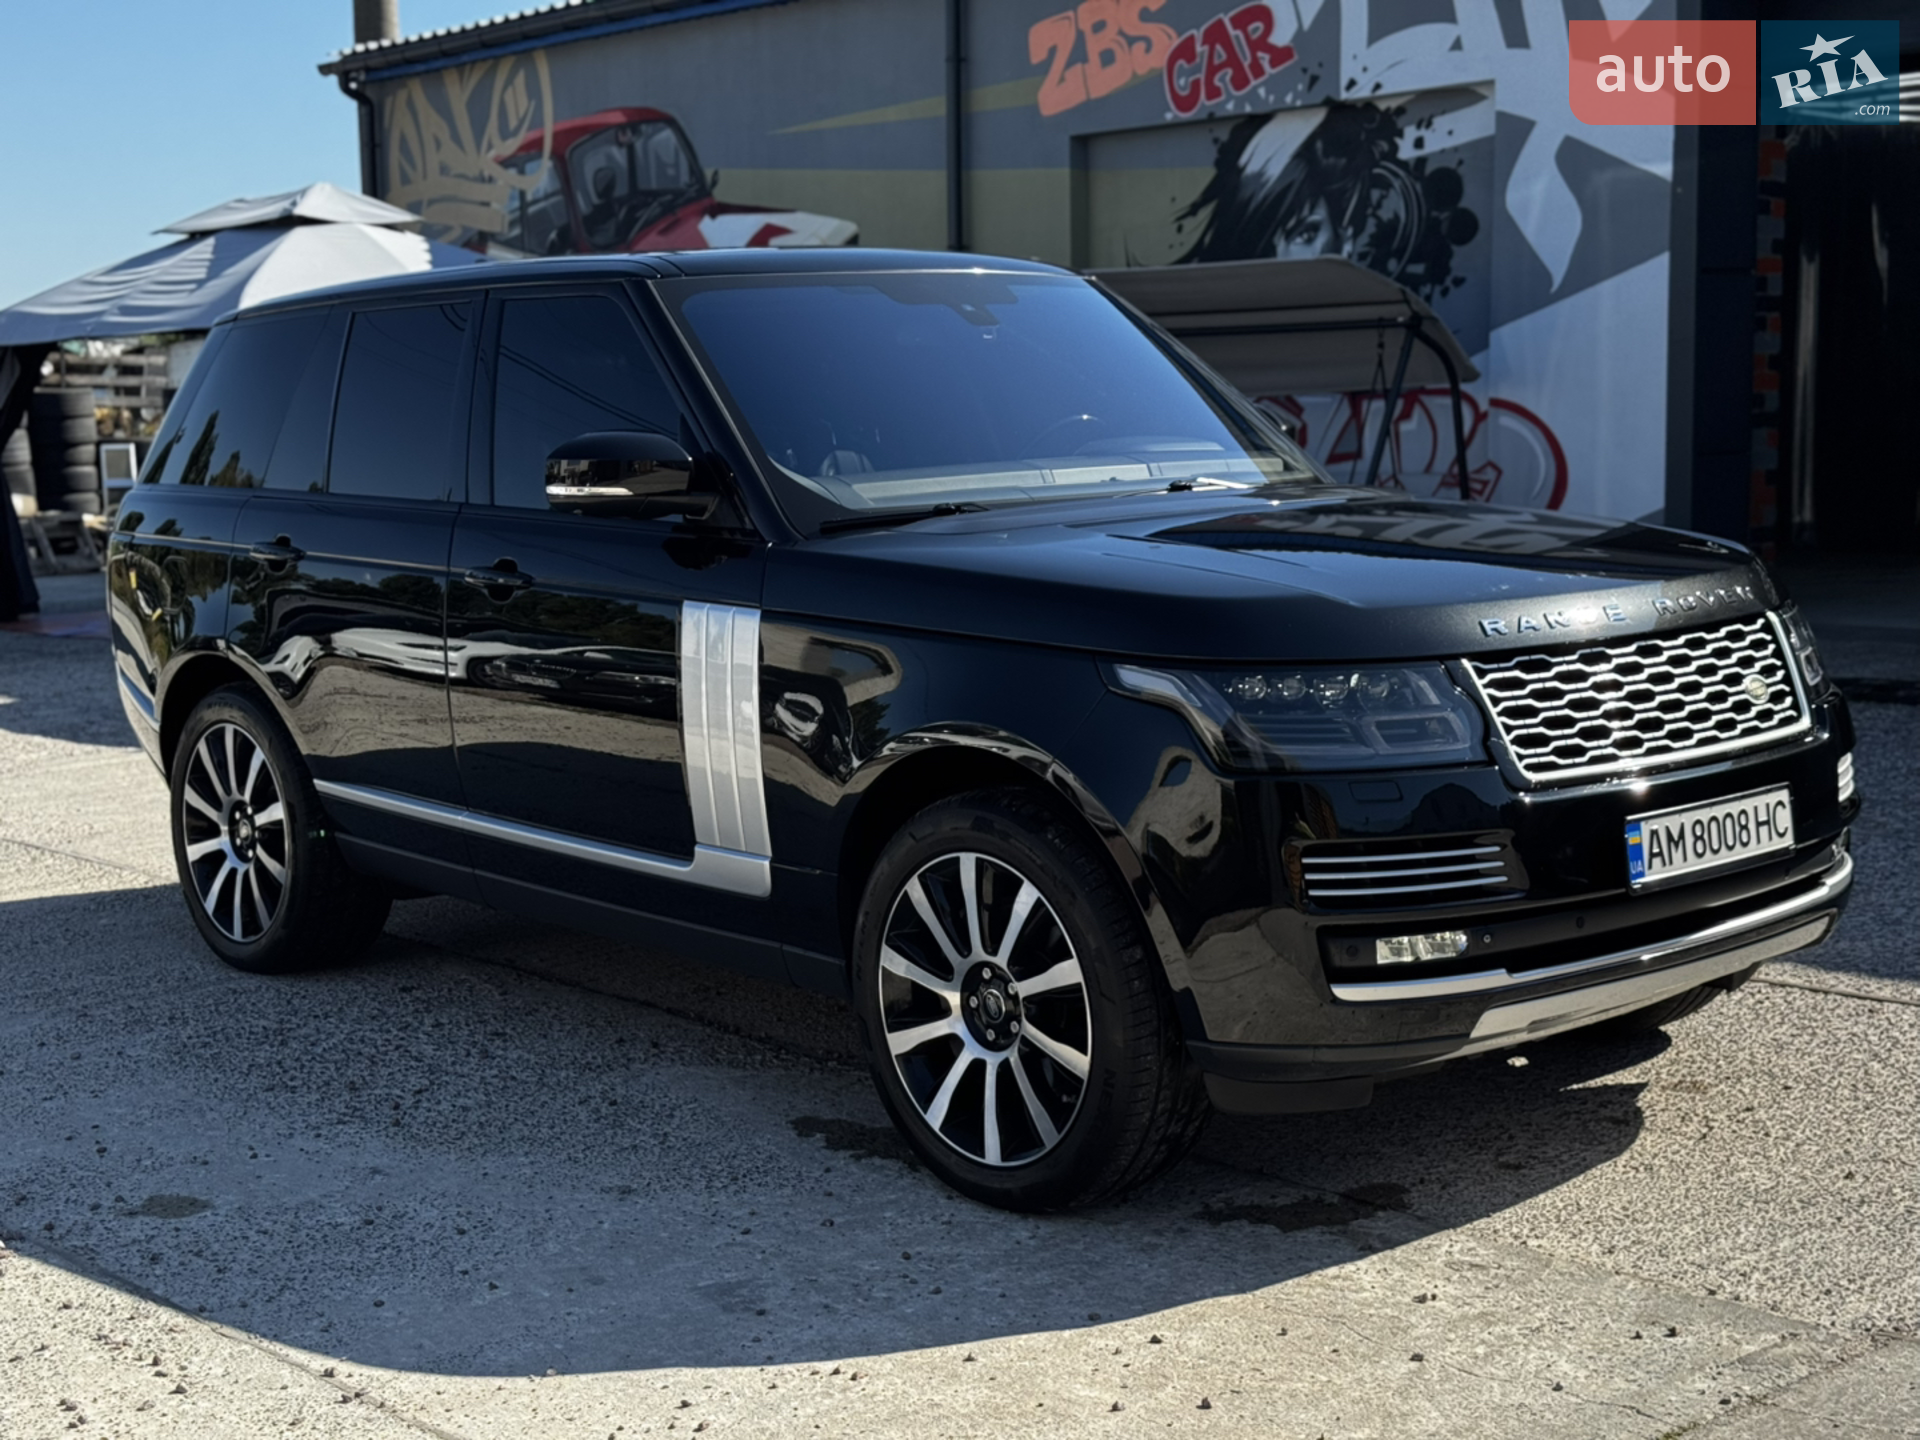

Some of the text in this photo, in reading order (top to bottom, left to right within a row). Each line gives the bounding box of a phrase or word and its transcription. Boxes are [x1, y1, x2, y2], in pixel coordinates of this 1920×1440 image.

[1028, 0, 1297, 117] ZBS CAR
[1479, 603, 1626, 638] RANE
[1630, 859, 1644, 875] UA
